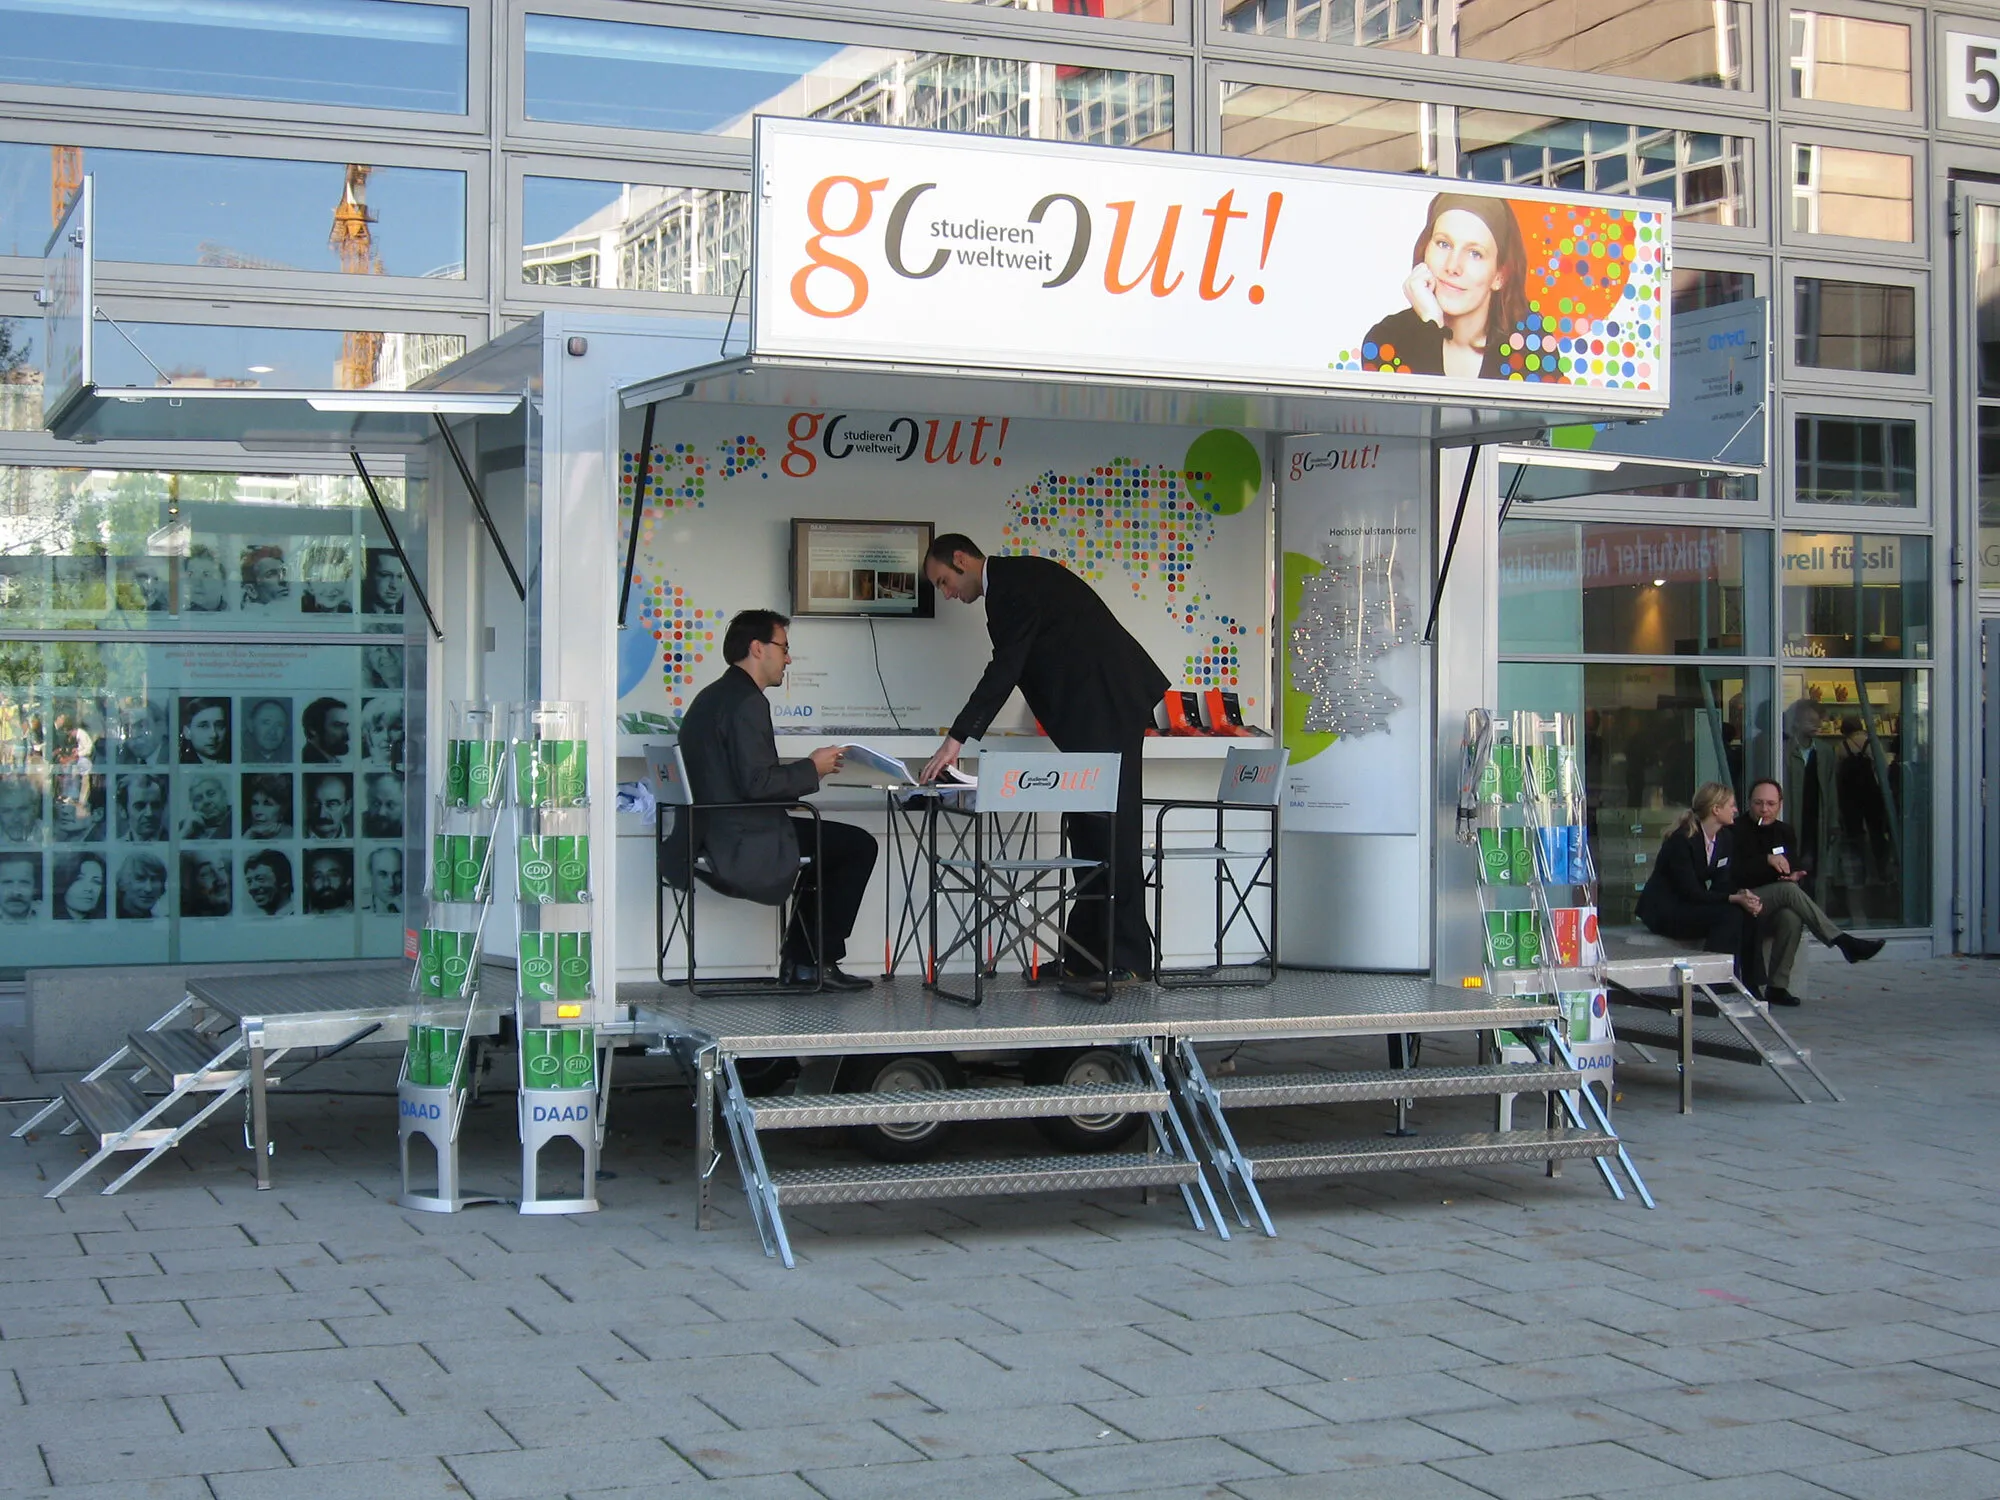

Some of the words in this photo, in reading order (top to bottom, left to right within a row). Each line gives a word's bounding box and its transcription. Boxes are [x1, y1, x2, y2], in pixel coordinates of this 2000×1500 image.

[1965, 44, 1999, 114] 5
[929, 216, 1035, 246] studieren
[955, 246, 1053, 273] weltweit
[843, 430, 893, 443] studieren
[855, 444, 901, 455] weltweit
[773, 705, 813, 717] DAAD
[1489, 853, 1506, 863] NZ
[526, 865, 549, 875] CDN
[563, 865, 581, 876] CH
[1493, 937, 1511, 946] PRC
[451, 960, 458, 973] J
[528, 961, 546, 973] DK
[571, 961, 579, 973] E
[541, 1059, 549, 1071] F
[569, 1059, 587, 1070] FIN
[1577, 1055, 1612, 1071] DAAD
[401, 1100, 441, 1120] DAAD
[533, 1106, 589, 1122] DAAD
